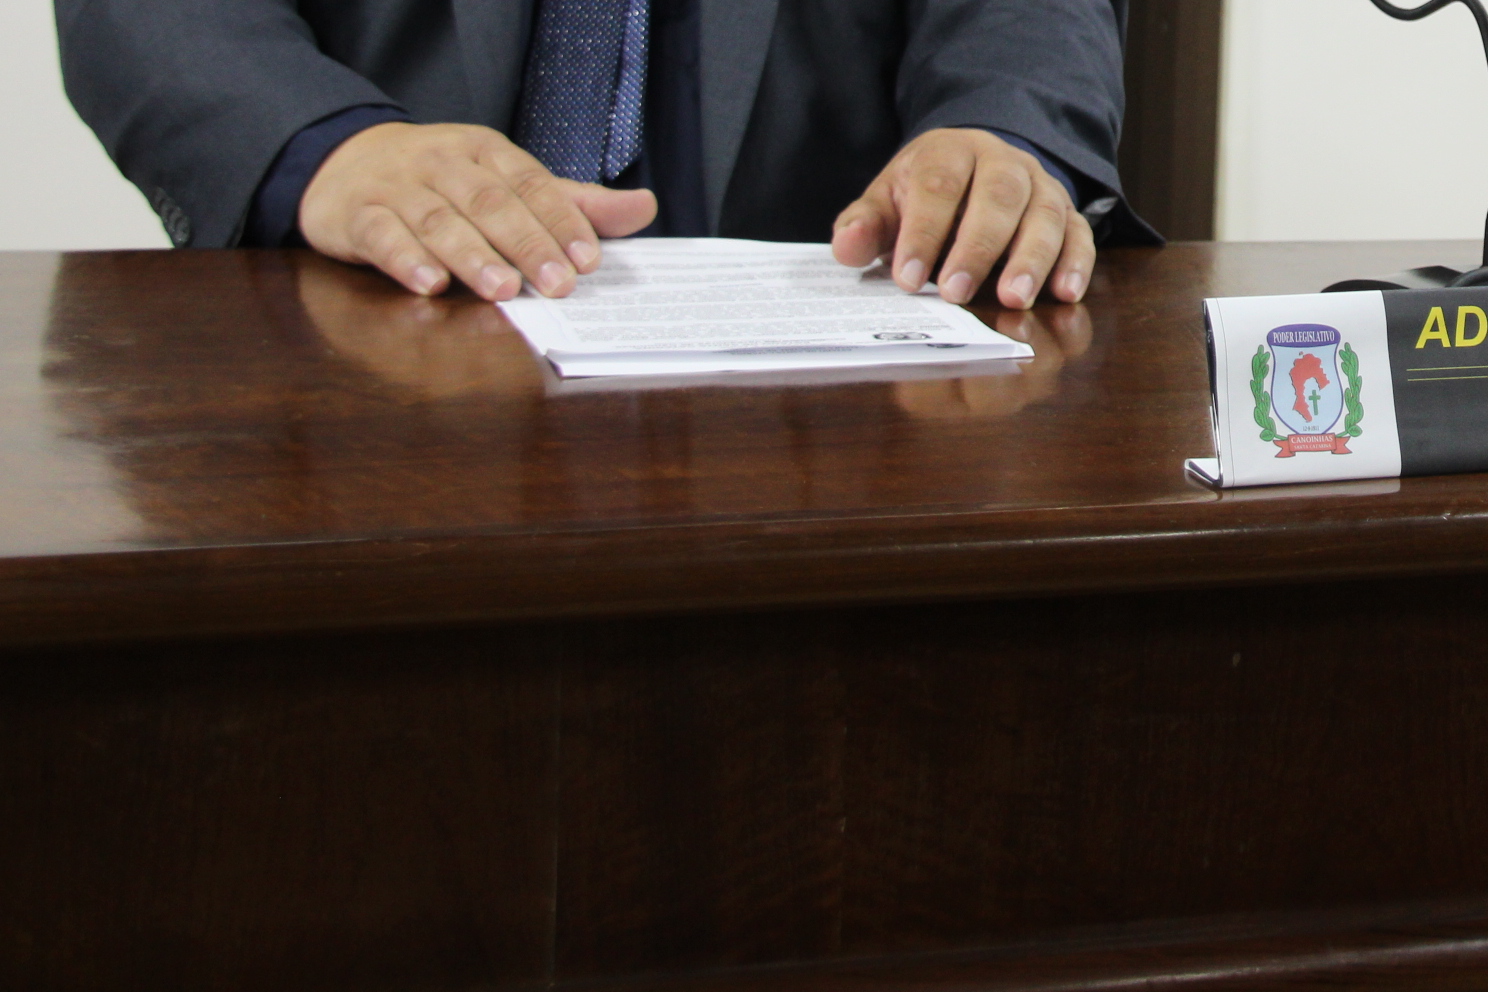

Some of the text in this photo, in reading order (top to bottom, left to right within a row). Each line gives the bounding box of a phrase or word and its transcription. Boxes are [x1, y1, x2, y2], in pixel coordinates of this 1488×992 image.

[1273, 330, 1335, 343] PODER LEGISLATIVO
[1290, 435, 1333, 444] CANOINHAS
